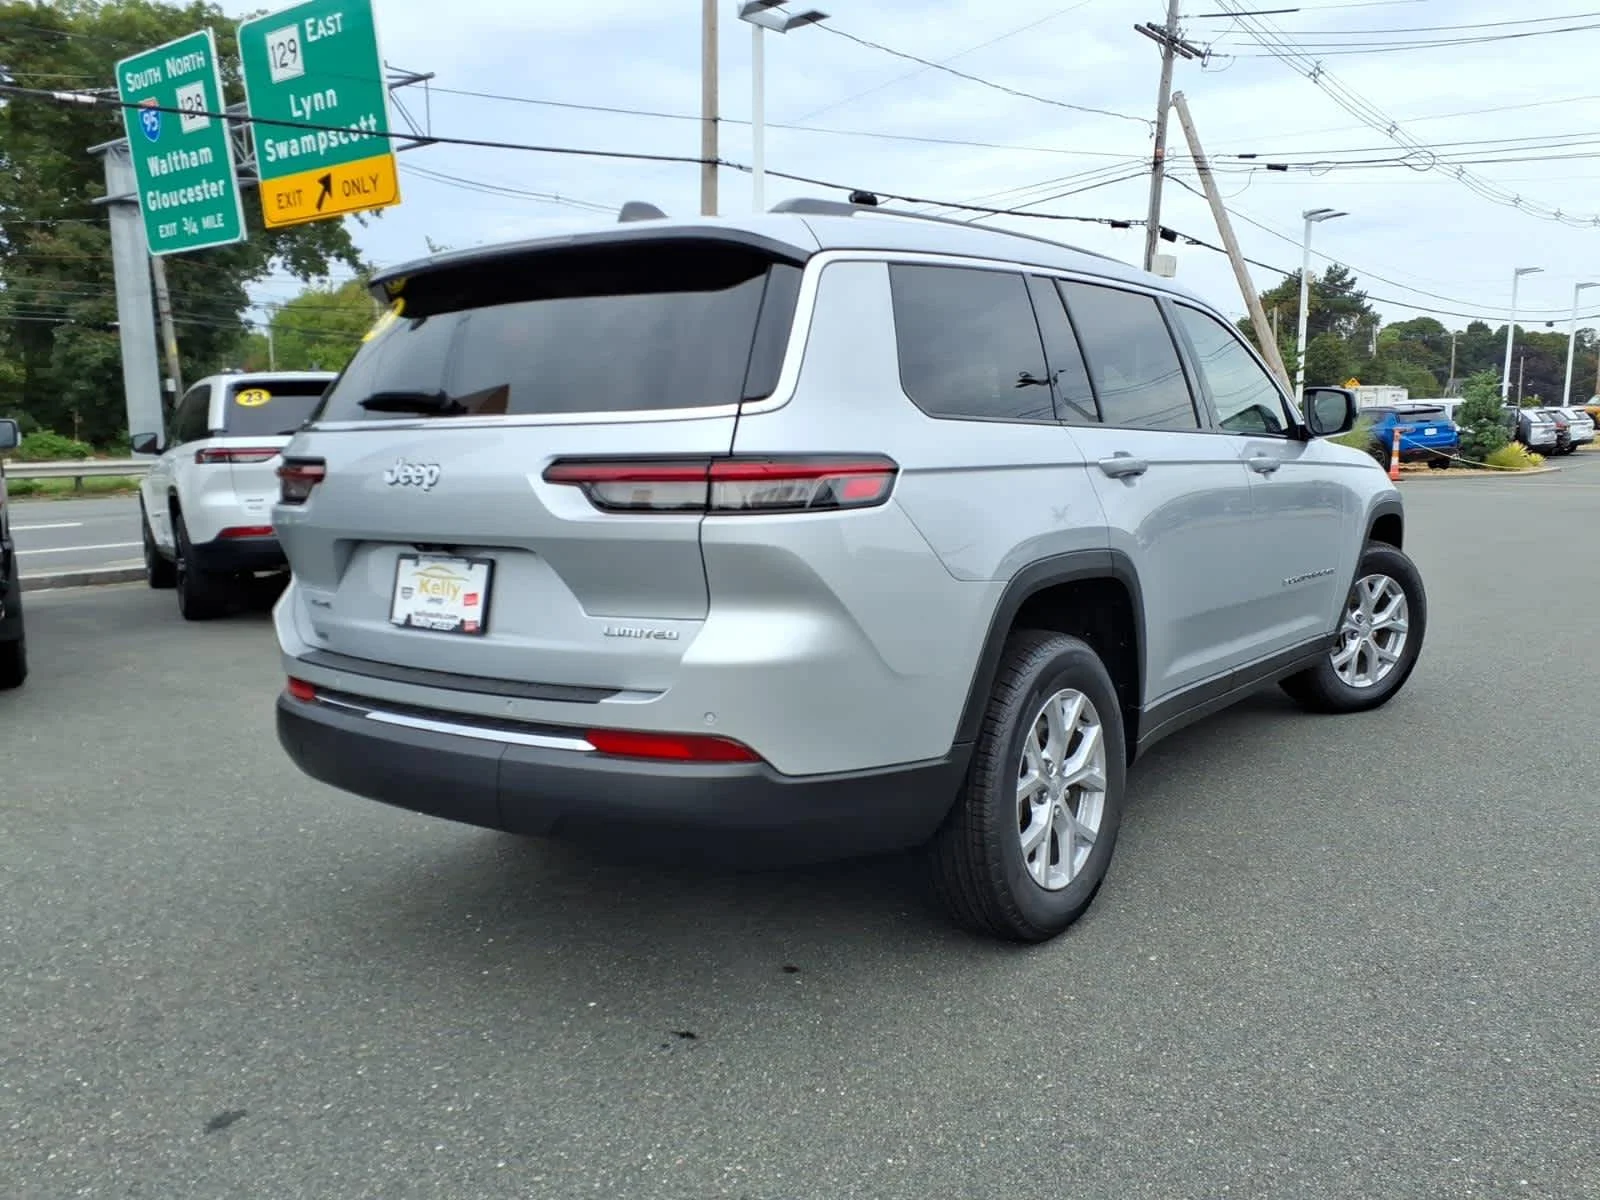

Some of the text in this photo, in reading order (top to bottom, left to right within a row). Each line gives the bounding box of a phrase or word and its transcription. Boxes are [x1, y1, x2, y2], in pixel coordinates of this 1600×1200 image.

[304, 12, 343, 42] EAST
[271, 38, 298, 70] 129
[125, 50, 205, 92] SOUTH NORTH
[181, 93, 205, 120] 128
[290, 87, 337, 121] Lynn
[143, 110, 159, 132] 95
[264, 113, 377, 162] Swampscott
[147, 147, 213, 178] Waltham
[146, 178, 225, 212] Gloucester
[276, 173, 379, 210] EXIT ONLY
[158, 221, 178, 239] EXIT
[201, 213, 225, 230] MILE
[245, 391, 263, 404] 23
[383, 456, 441, 492] Jeep
[419, 578, 462, 603] Kelly
